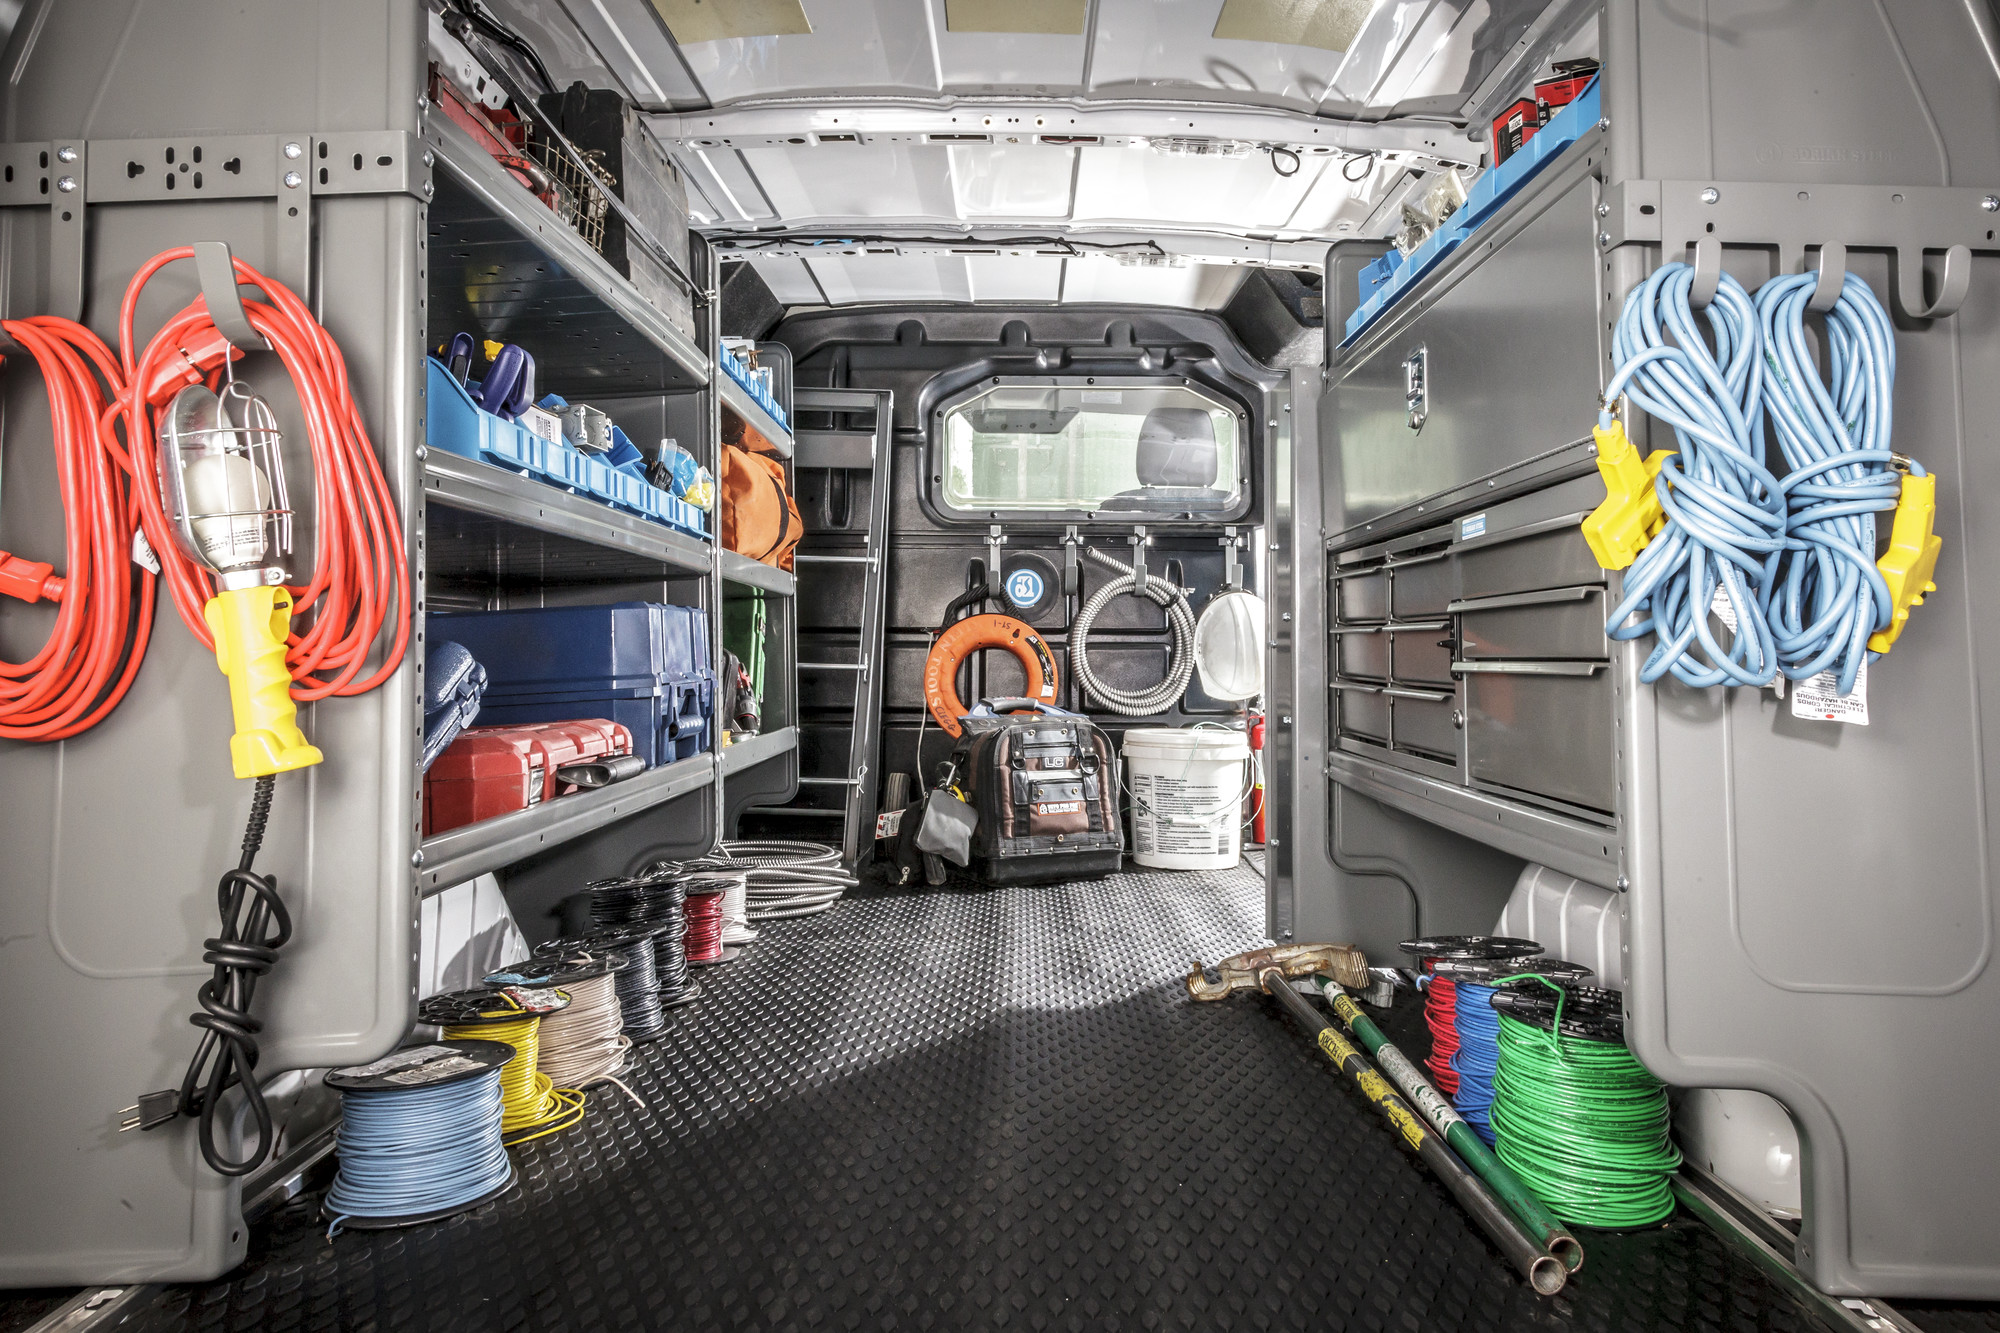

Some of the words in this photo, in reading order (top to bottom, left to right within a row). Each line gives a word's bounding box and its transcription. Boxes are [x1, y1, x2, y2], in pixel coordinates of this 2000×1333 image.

[1795, 692, 1838, 703] HAZARDOUS
[1796, 698, 1821, 707] CORDS
[1044, 756, 1064, 768] LC
